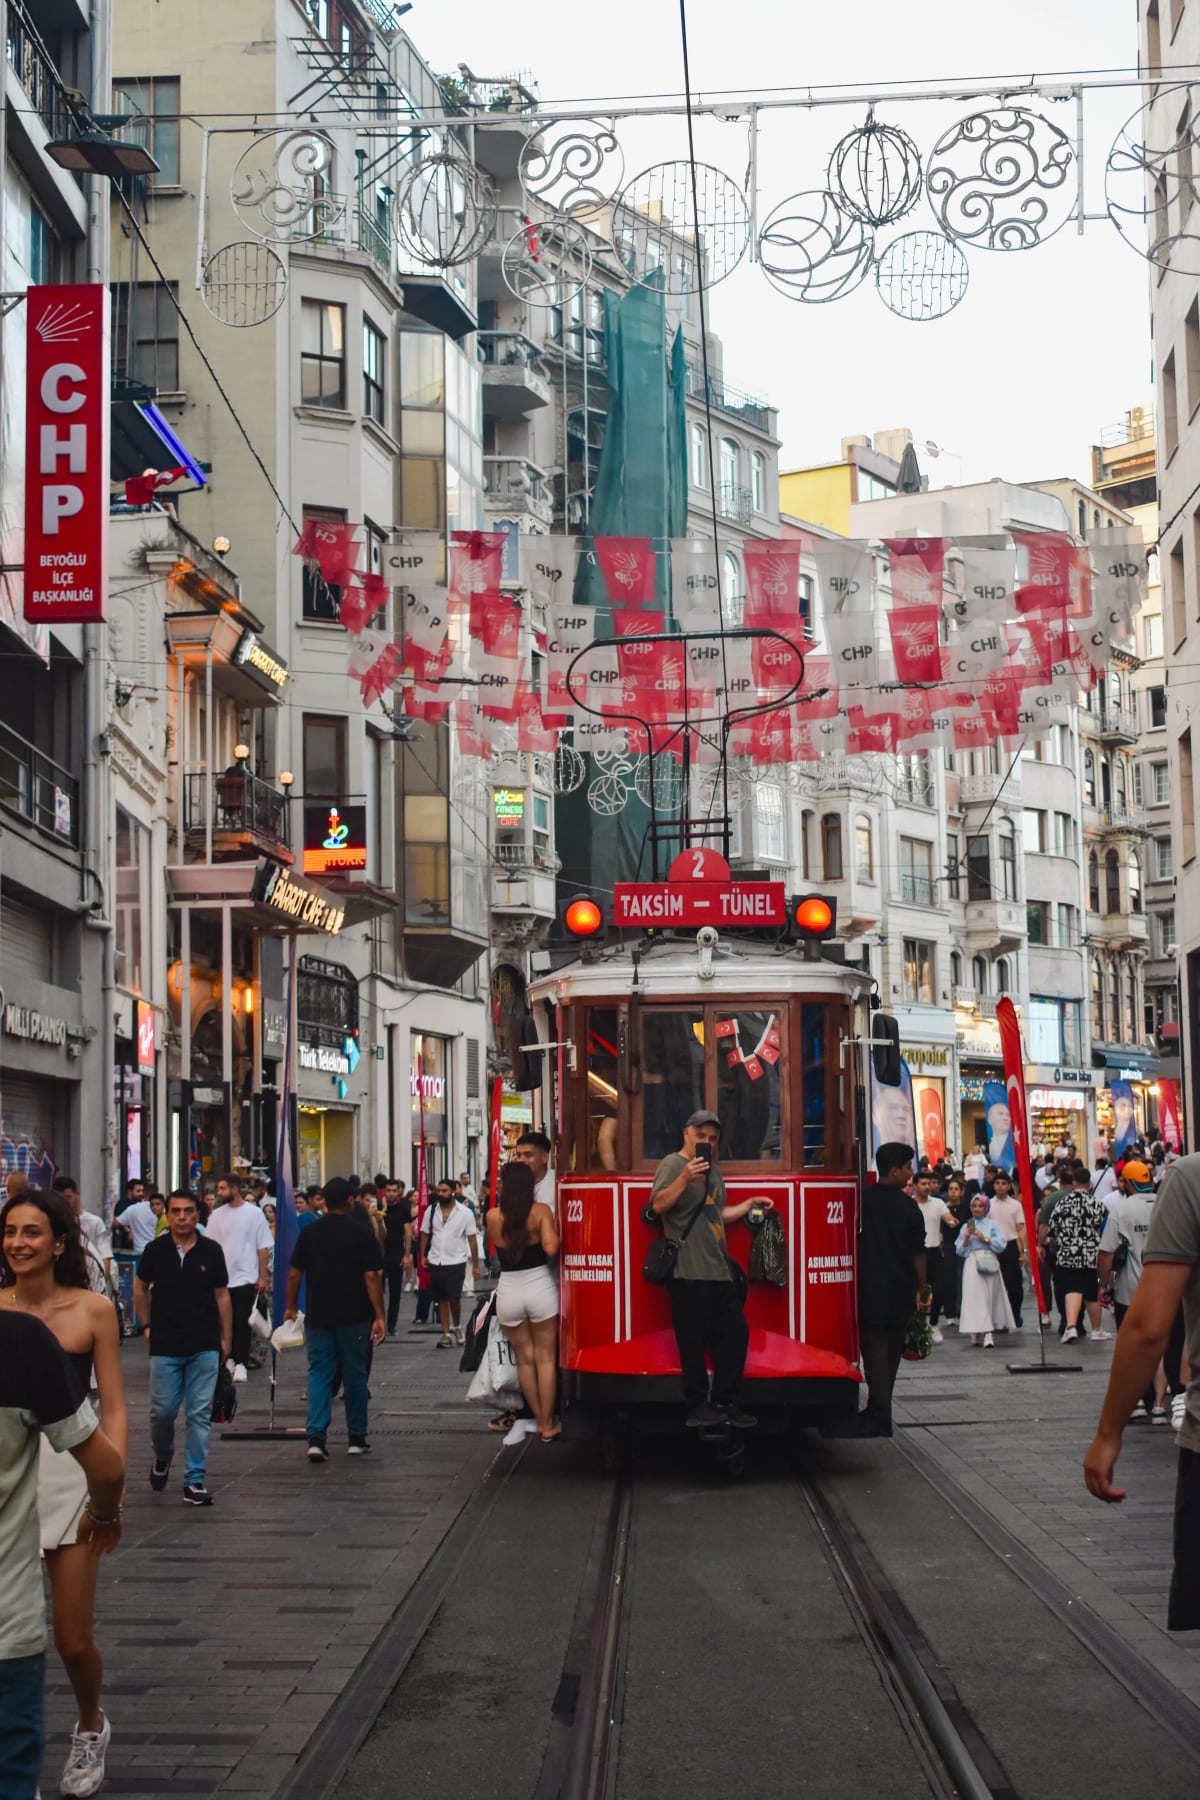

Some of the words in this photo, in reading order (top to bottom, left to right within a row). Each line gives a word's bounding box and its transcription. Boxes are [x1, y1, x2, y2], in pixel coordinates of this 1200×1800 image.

[40, 363, 87, 535] CHP
[40, 551, 87, 567] BEYOĞLU
[389, 556, 424, 569] CHP
[52, 570, 74, 587] İLÇE
[32, 587, 94, 605] BAŞKANLIĞI
[1043, 629, 1061, 641] CH
[624, 643, 654, 655] CHP
[690, 647, 720, 660] CHP
[842, 645, 873, 661] CHP
[906, 645, 935, 658] CHP
[763, 653, 792, 666] CHP
[481, 673, 509, 688] CHP
[590, 670, 619, 683] CHP
[655, 679, 681, 690] CHP
[730, 679, 751, 691] HP
[1035, 694, 1062, 707] CHP
[1017, 711, 1035, 723] CH
[922, 719, 950, 730] CHP
[701, 732, 718, 745] CH
[500, 818, 519, 826] CAFE
[692, 851, 705, 878] 2
[270, 878, 308, 917] PARROT
[302, 893, 327, 926] CAFE
[620, 888, 683, 917] TAKSİM
[720, 888, 776, 916] TÜNEL
[299, 1045, 318, 1069] Türk
[318, 1049, 349, 1074] Telekom
[567, 1199, 583, 1222] 223
[826, 1201, 844, 1224] 223
[588, 1254, 613, 1267] YASAK
[807, 1255, 839, 1269] ASILMAK
[808, 1272, 818, 1285] VE
